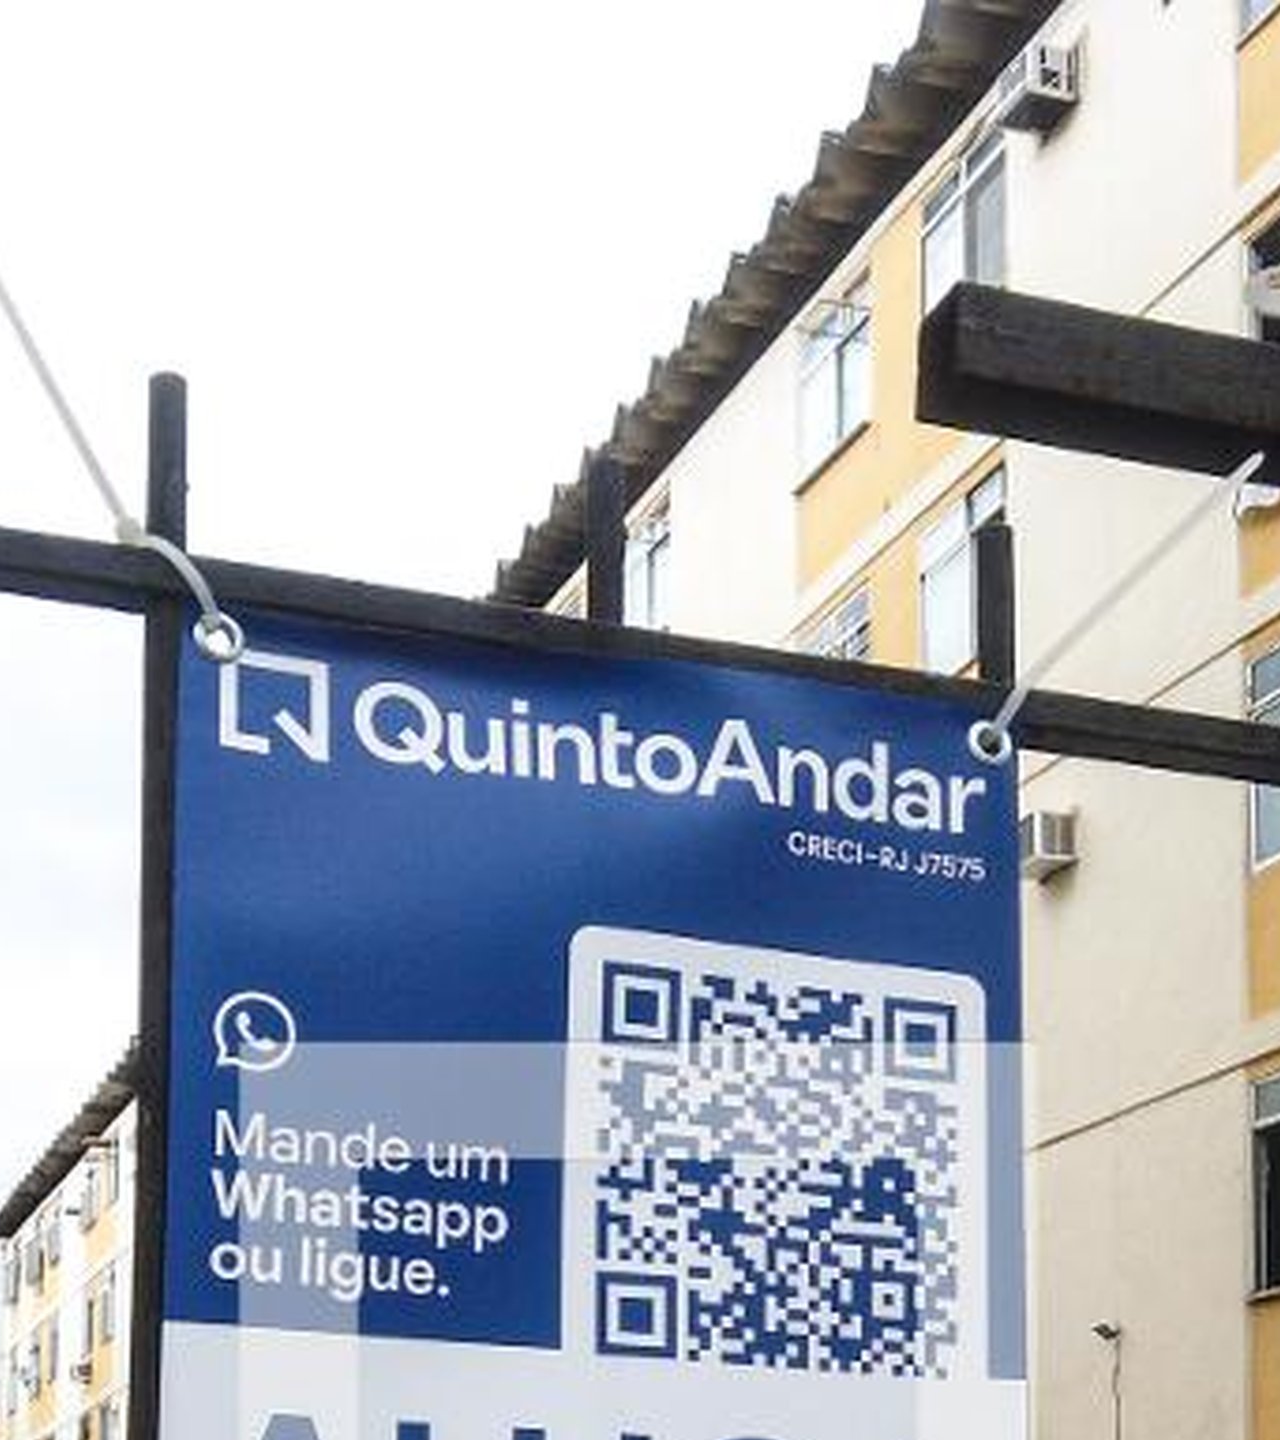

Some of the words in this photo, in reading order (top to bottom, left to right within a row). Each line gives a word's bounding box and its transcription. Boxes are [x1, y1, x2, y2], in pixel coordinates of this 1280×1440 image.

[353, 681, 986, 833] QuintoAndar
[786, 831, 908, 870] CRECI-RJ
[913, 852, 986, 880] J7575
[214, 1109, 412, 1173] Mande
[424, 1140, 509, 1186] um
[211, 1168, 510, 1253] Whatsapp
[209, 1242, 283, 1285] ou
[299, 1236, 452, 1302] ligue.
